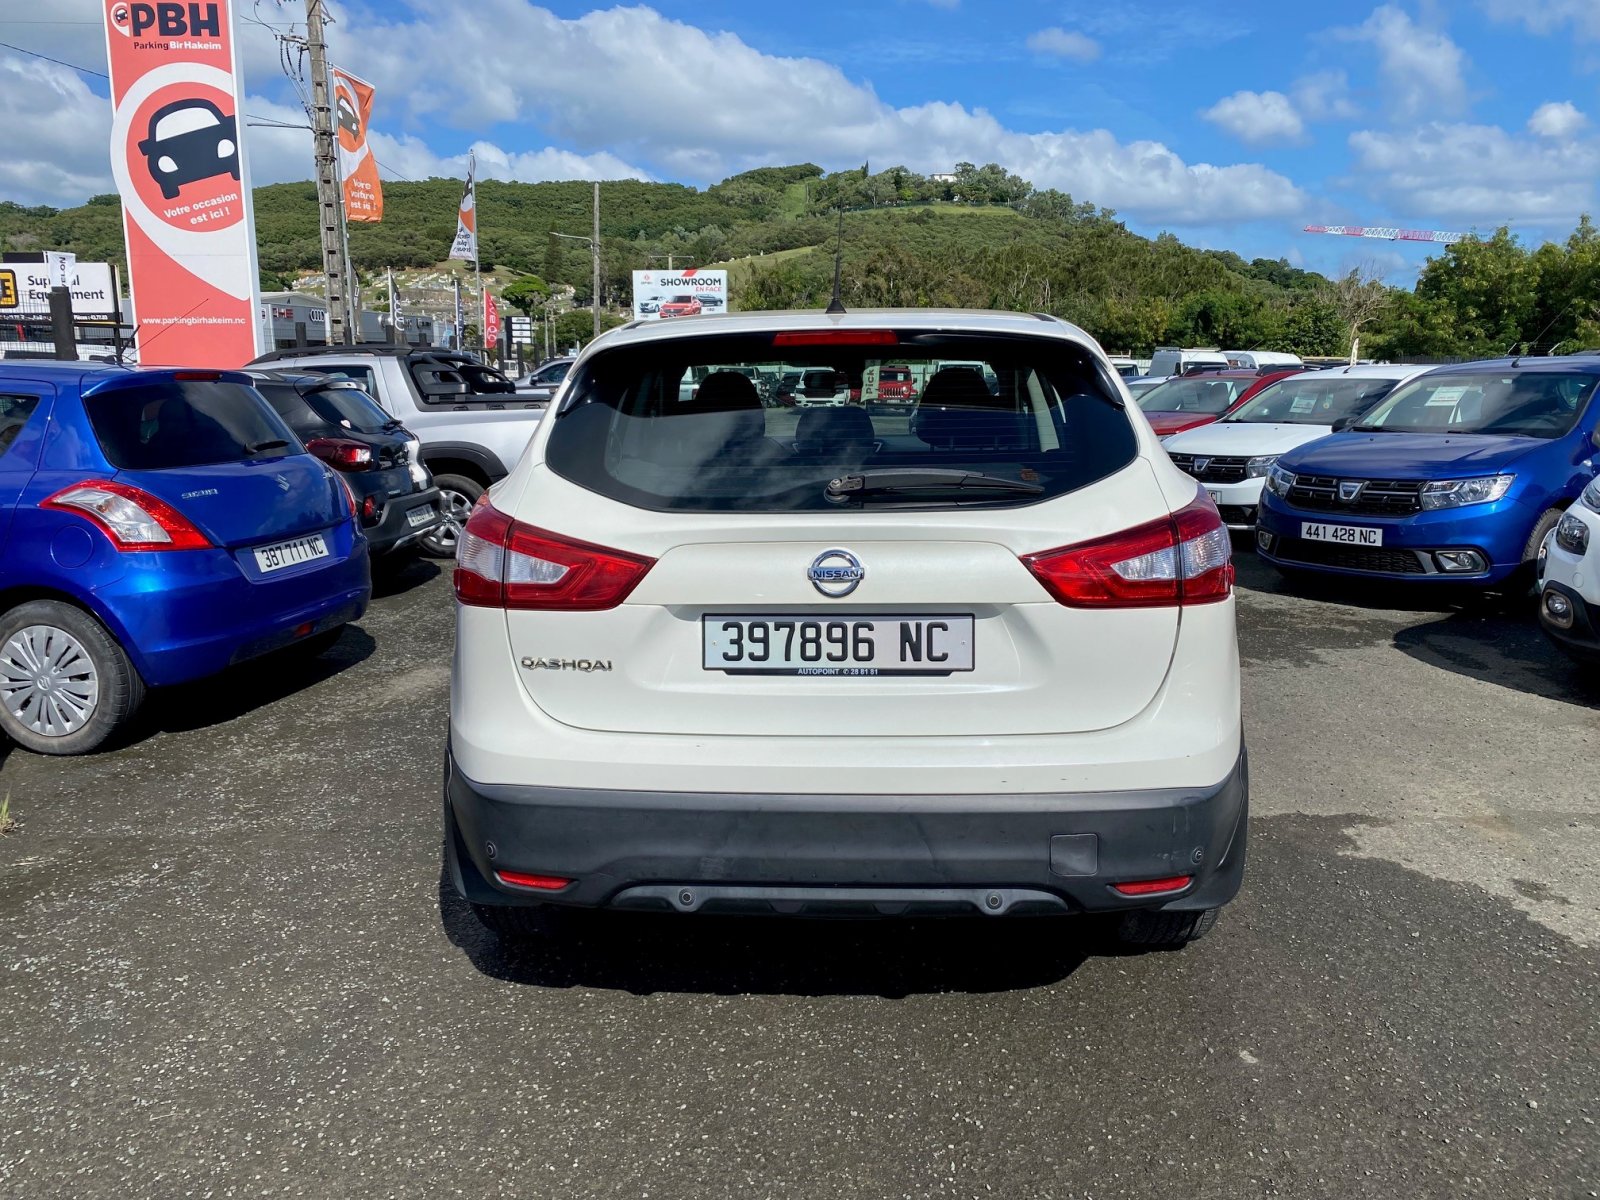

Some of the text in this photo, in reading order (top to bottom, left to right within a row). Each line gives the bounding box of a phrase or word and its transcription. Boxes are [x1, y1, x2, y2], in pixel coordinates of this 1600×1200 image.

[131, 3, 220, 36] PBH
[164, 193, 238, 218] Votre occasion
[190, 213, 208, 224] est
[209, 207, 224, 219] ici
[661, 278, 722, 286] SHOWROOM
[142, 316, 246, 326] www.parkingbirhakeim.nc
[866, 369, 874, 394] Pick
[1306, 524, 1376, 544] 441 428 NC
[262, 537, 324, 568] 387 711 NC
[813, 570, 859, 579] NISSAN
[722, 621, 949, 662] 397896 NC
[521, 656, 613, 673] QASHQAI
